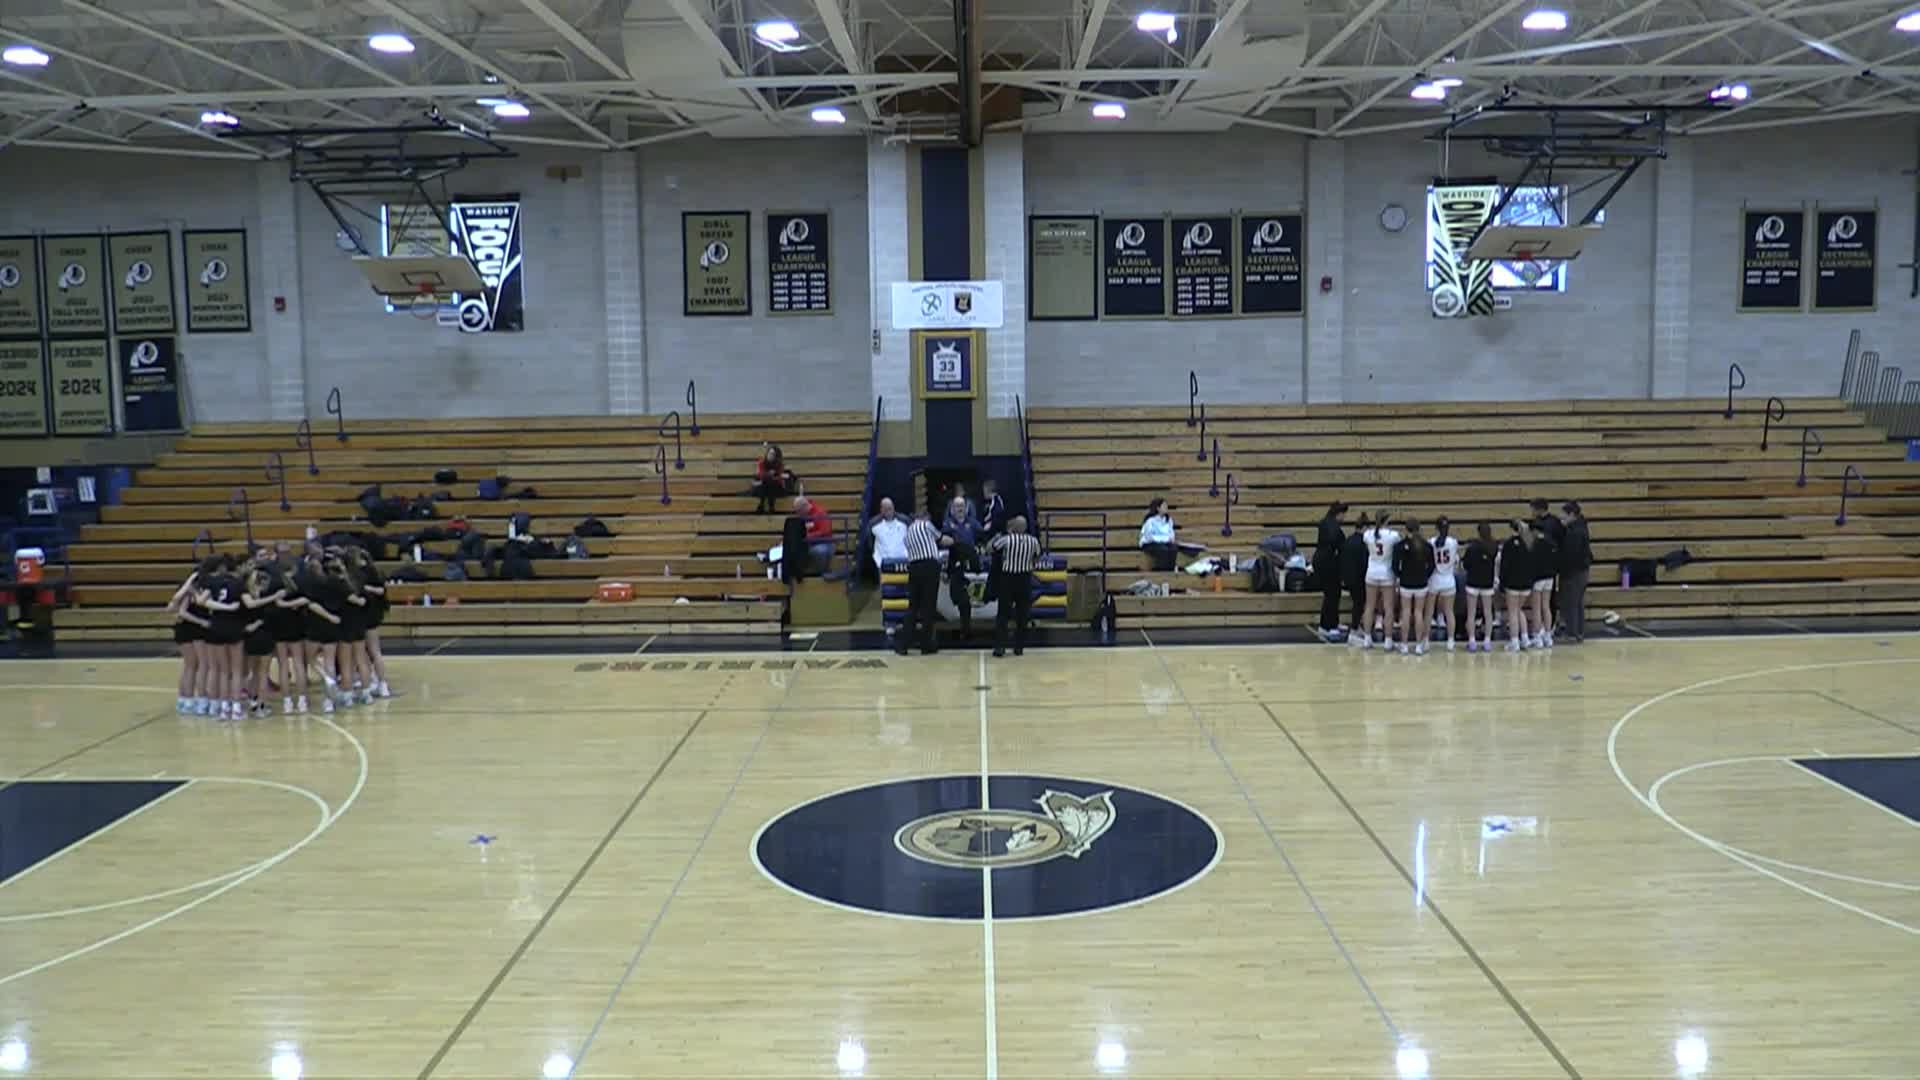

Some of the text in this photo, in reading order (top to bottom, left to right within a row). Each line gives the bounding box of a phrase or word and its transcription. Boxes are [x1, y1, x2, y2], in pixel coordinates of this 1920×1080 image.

[1442, 191, 1485, 199] WARRIOR
[466, 208, 509, 216] WARRIOR
[704, 219, 730, 228] GIRLS
[466, 218, 511, 287] FOCUS
[782, 253, 816, 262] LEAGUE
[1117, 258, 1152, 266] LEAGUE
[1185, 257, 1219, 266] LEAGUE
[1247, 255, 1296, 264] SECTIONAL
[771, 263, 827, 272] CHAMPIONS
[1107, 267, 1162, 275] CHAMPIONS
[1176, 266, 1230, 275] CHAMPIONS
[1245, 264, 1299, 273] CHAMPIONS
[704, 287, 731, 296] STATE
[690, 297, 746, 306] CHAMPIONS
[940, 360, 955, 372] 33
[0, 381, 37, 396] 2024
[60, 378, 103, 395] 2024
[1375, 543, 1384, 556] 3
[1437, 549, 1450, 564] 15
